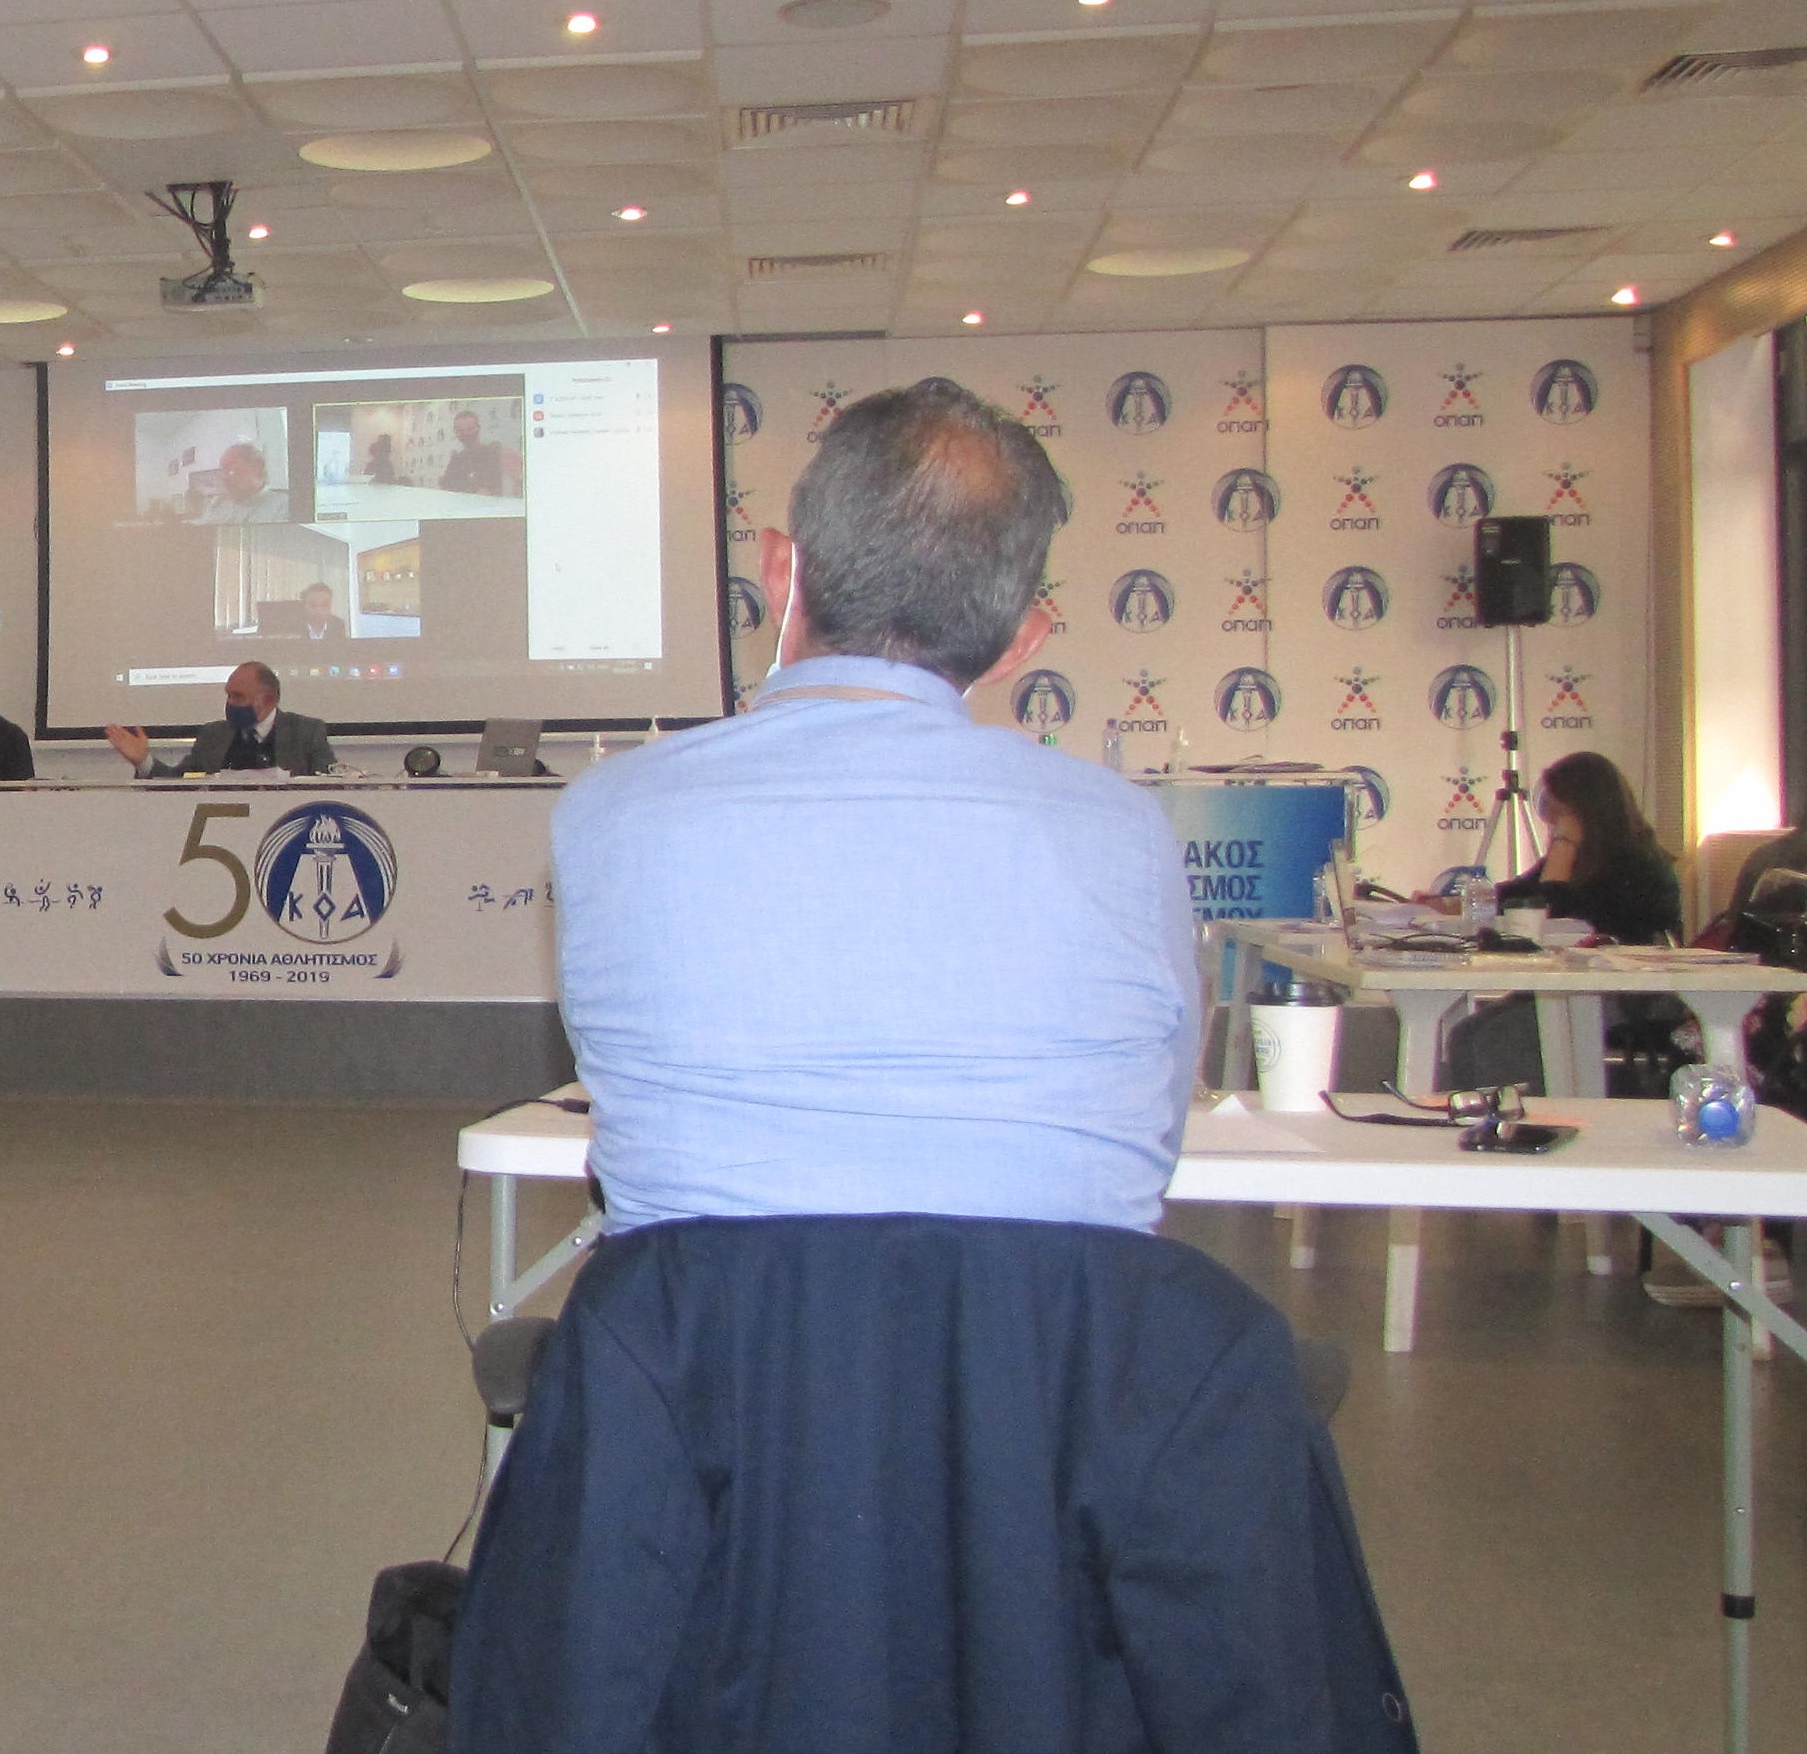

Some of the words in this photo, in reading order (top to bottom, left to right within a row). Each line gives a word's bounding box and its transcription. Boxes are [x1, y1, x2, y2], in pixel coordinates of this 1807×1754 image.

[182, 952, 202, 965] 50
[207, 953, 267, 965] ΧΡΟΝΙΑ
[271, 953, 378, 966] ΑΘΛΗΤΙΣΜΟΣ
[229, 970, 271, 982] 1969
[287, 971, 330, 982] 2019
